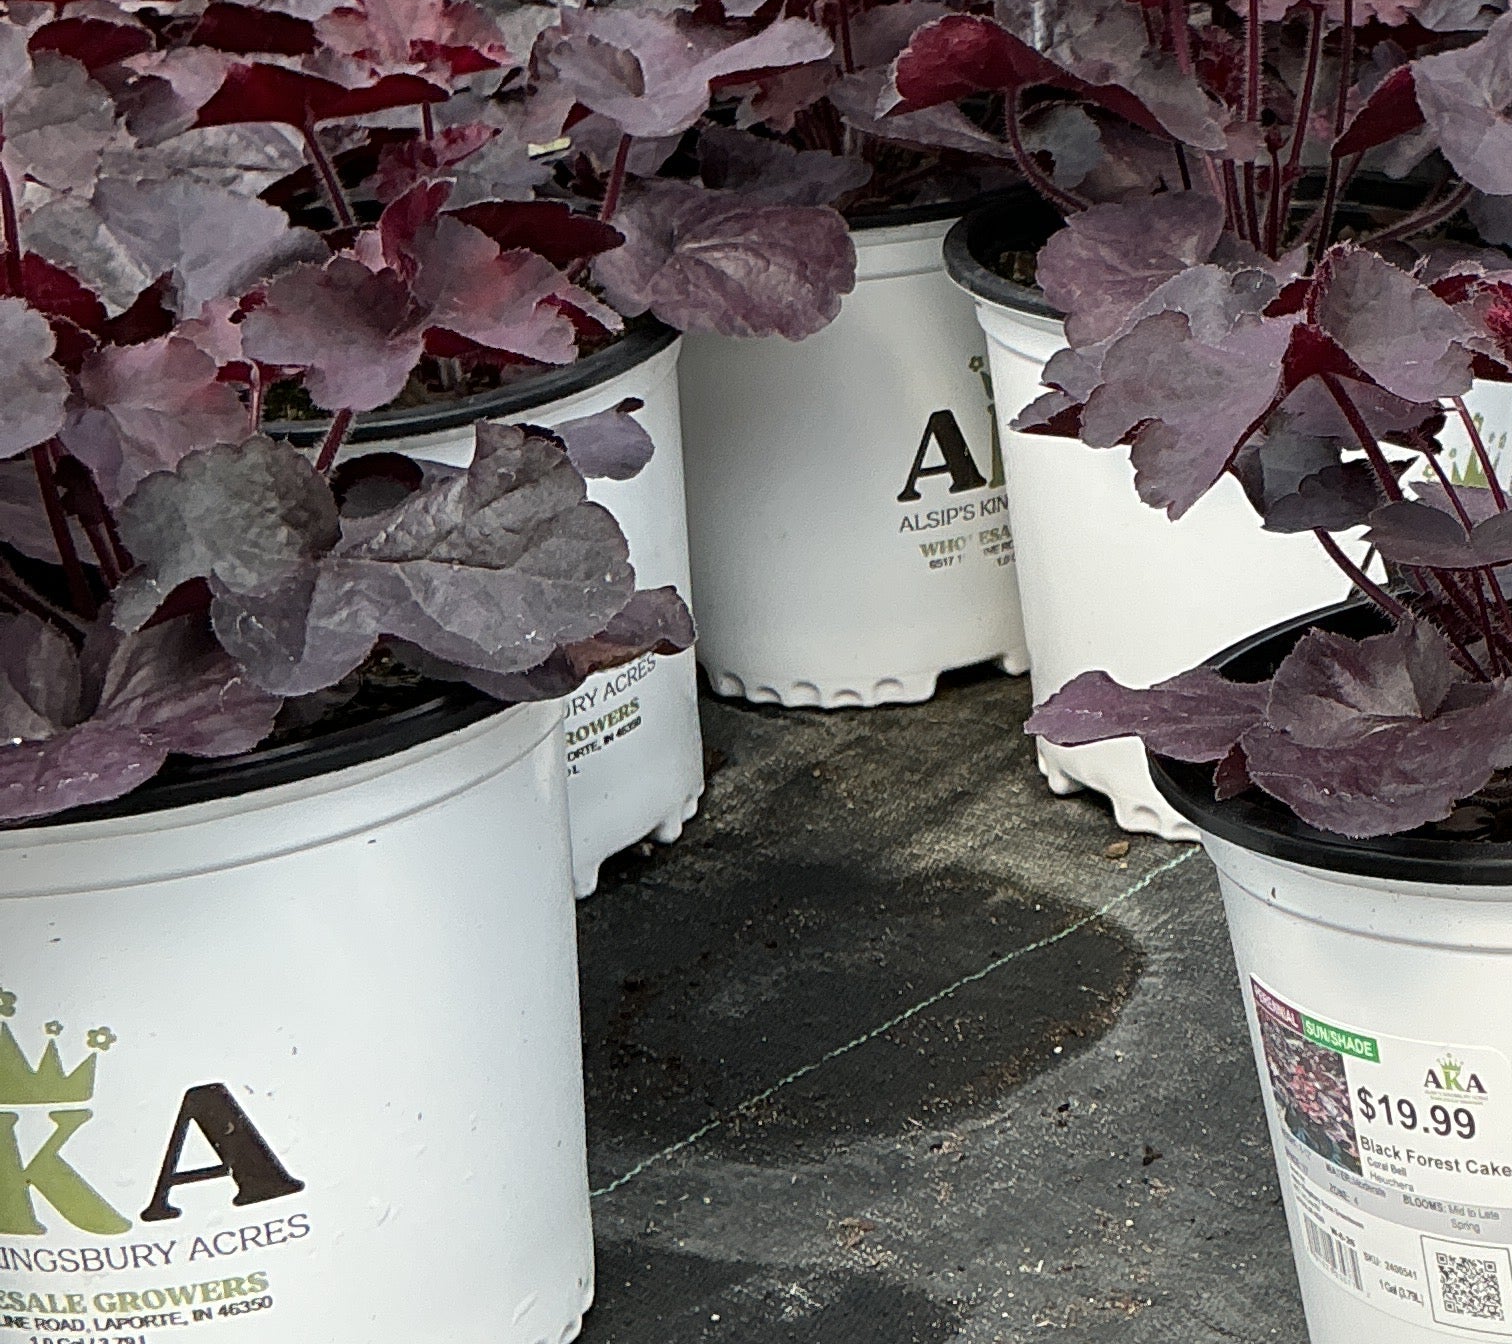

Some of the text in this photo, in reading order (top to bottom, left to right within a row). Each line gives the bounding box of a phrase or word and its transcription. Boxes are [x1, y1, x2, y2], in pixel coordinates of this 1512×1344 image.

[899, 504, 975, 533] ALSIP'S
[603, 651, 656, 701] ACRES
[566, 697, 640, 745] ROWERS
[1305, 1020, 1374, 1056] SUN/SHADE
[1424, 1068, 1488, 1093] AKA
[1357, 1086, 1476, 1139] $19.99
[0, 1083, 305, 1235] KA
[1360, 1135, 1512, 1177] Black Forest Cake
[0, 1214, 310, 1272] INGSBURY ACRES
[0, 1271, 269, 1314] SALE GROWERS
[192, 1307, 212, 1321] IN
[218, 1295, 273, 1317] 46350
